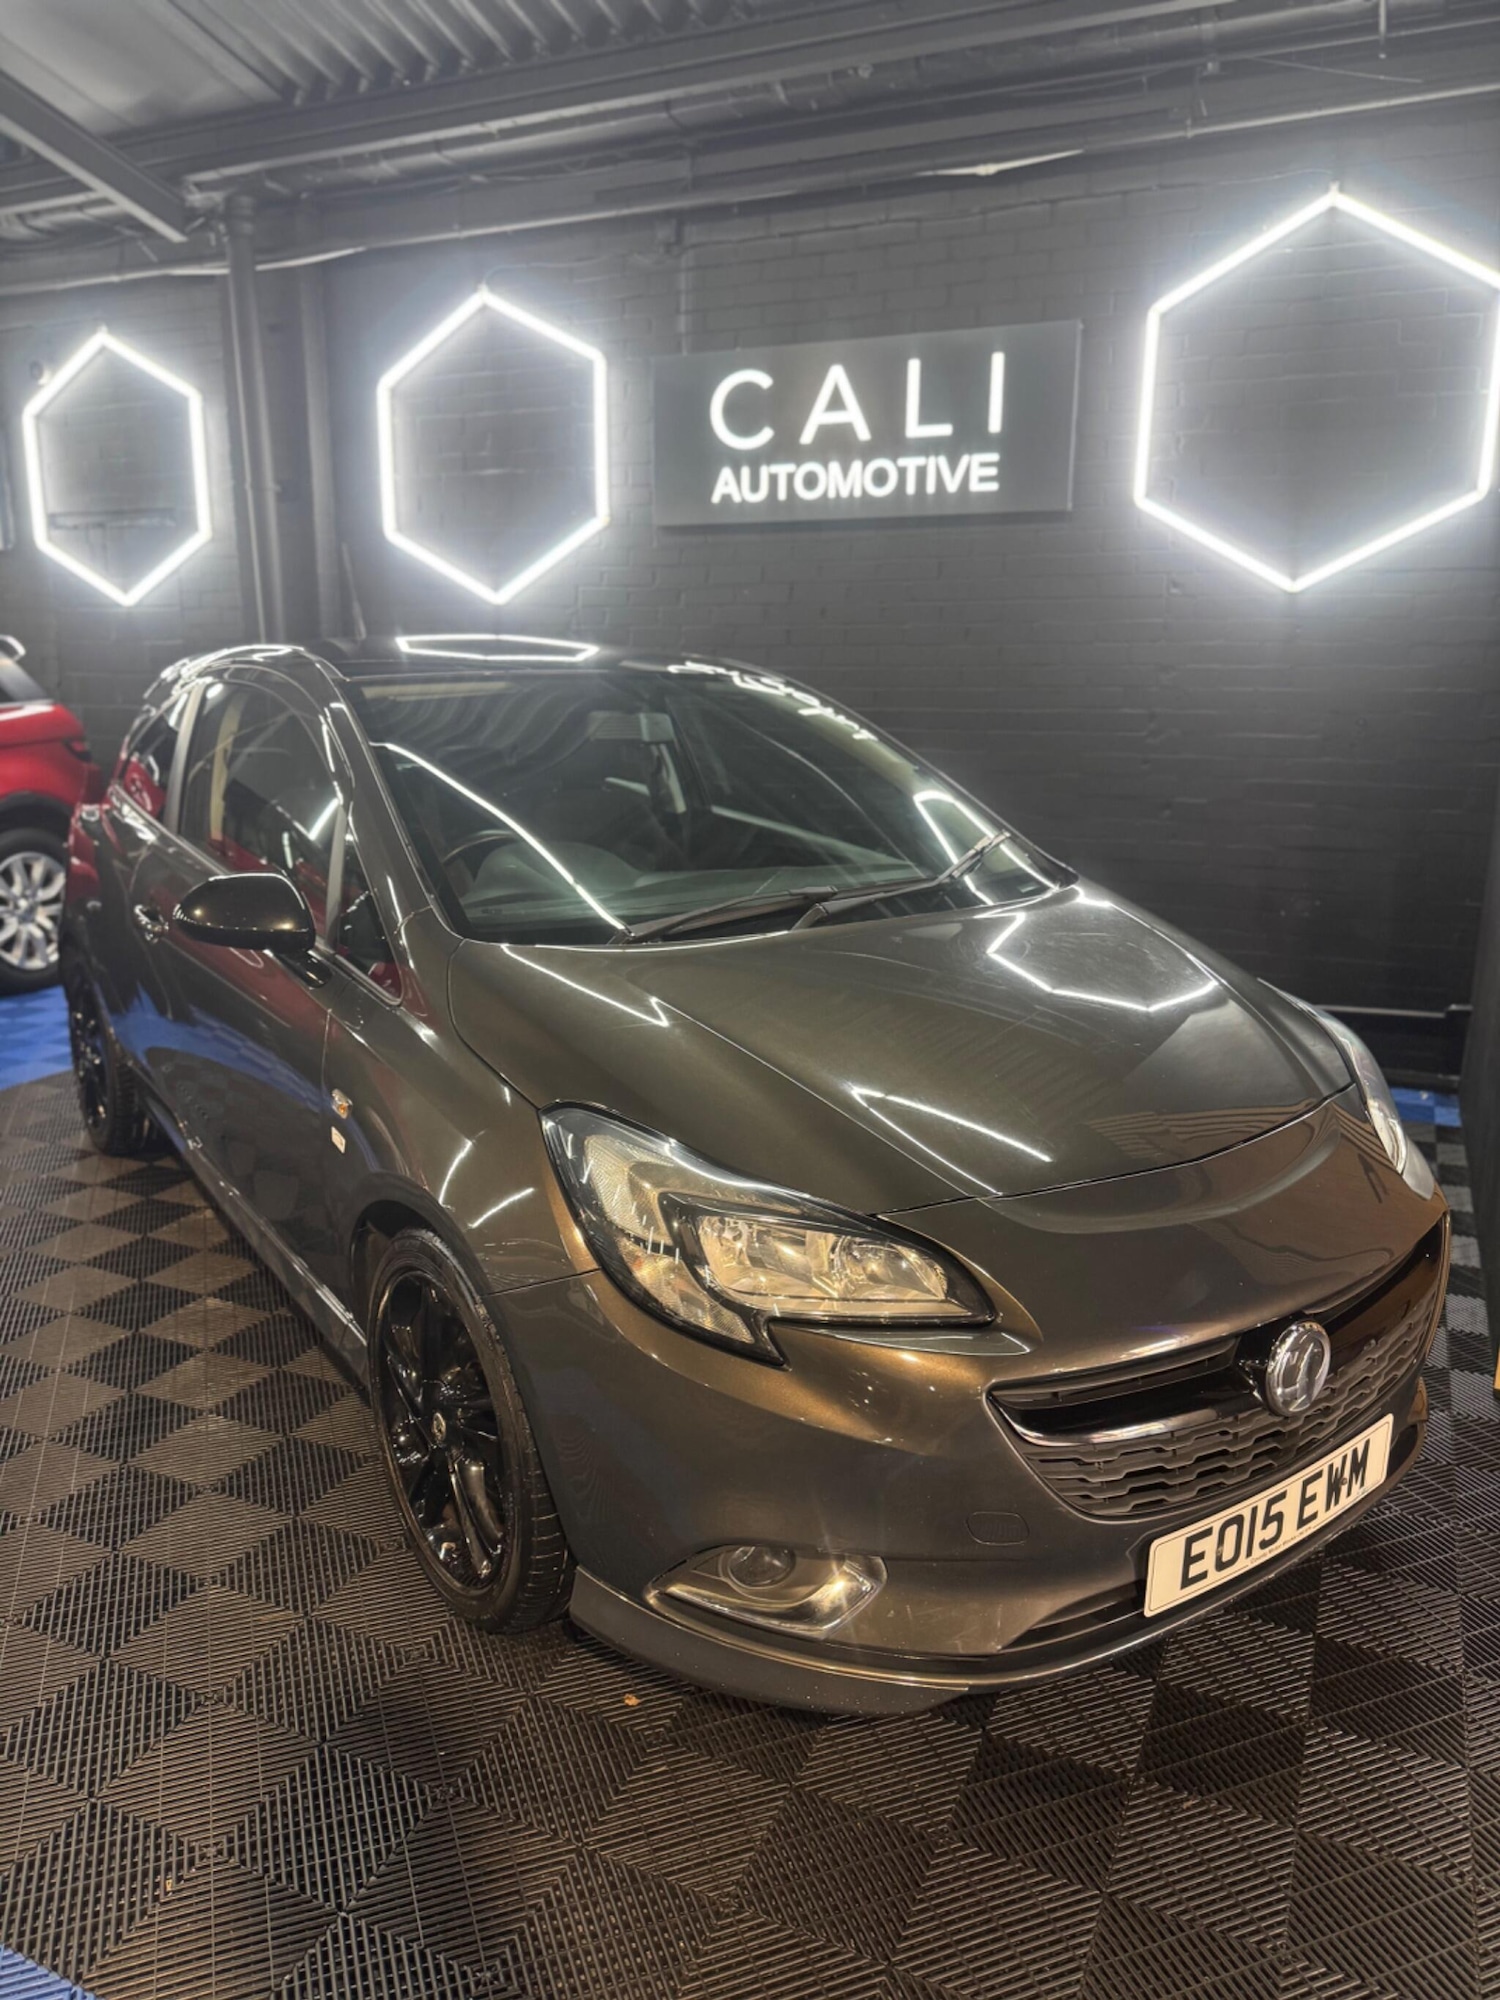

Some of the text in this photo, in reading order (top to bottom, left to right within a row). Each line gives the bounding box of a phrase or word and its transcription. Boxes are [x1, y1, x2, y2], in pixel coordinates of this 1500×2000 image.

[710, 352, 1005, 450] CALI
[711, 453, 1000, 504] AUTOMOTIVE
[1180, 1438, 1370, 1591] EO15 EWM
